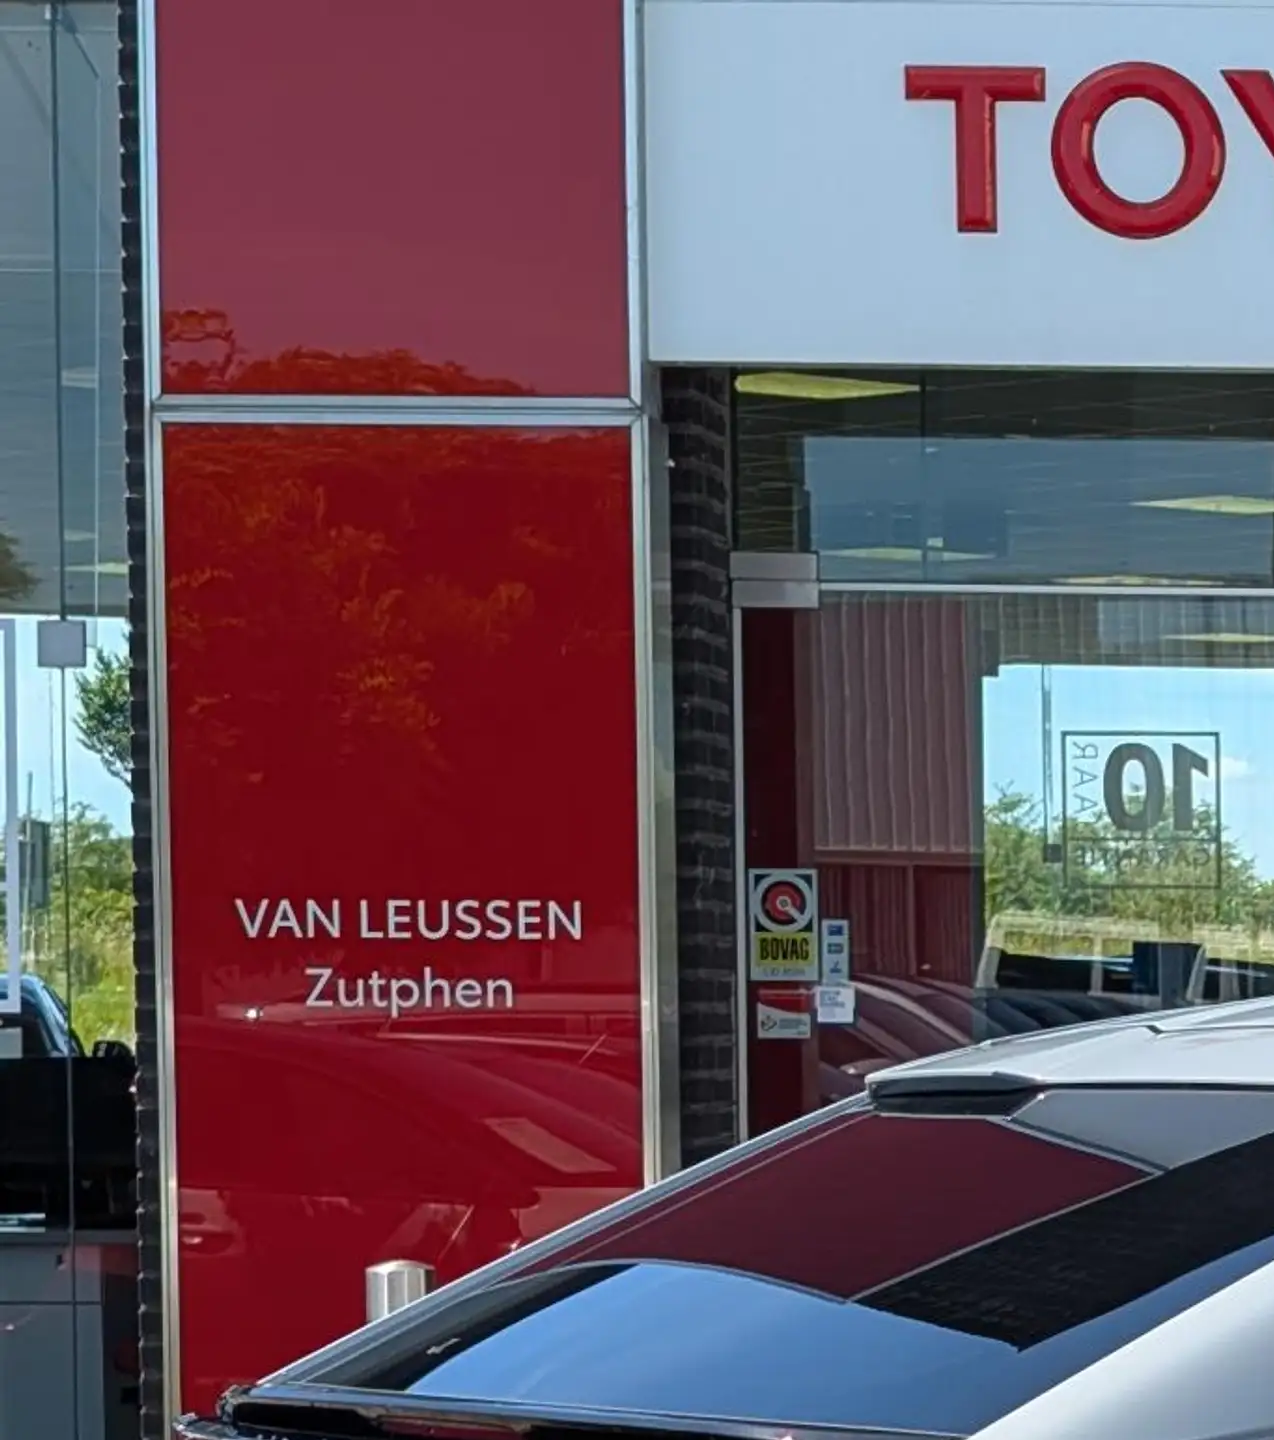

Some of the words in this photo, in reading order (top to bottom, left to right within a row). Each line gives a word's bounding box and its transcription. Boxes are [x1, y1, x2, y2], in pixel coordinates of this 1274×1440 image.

[234, 898, 341, 939] VAN
[359, 899, 582, 941] LEUSSEN
[759, 937, 810, 962] BOVAG
[304, 966, 514, 1019] Zutphen
